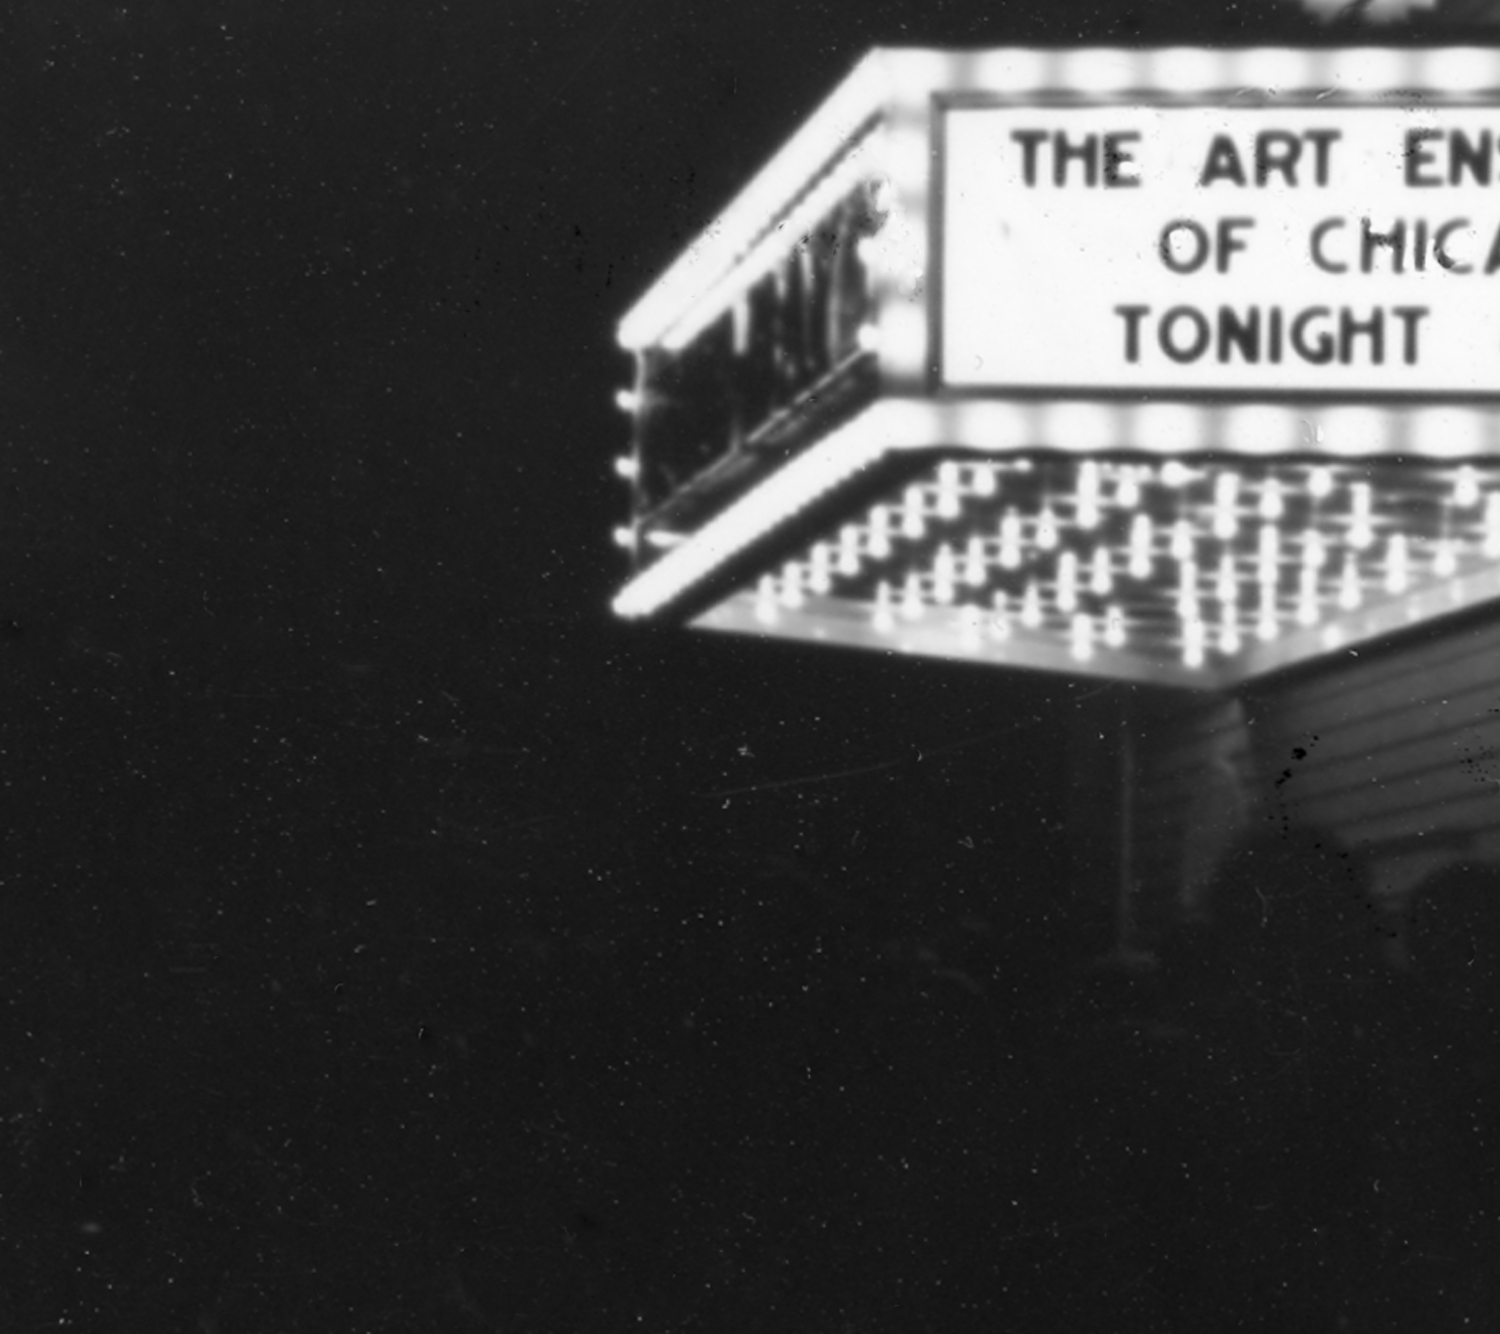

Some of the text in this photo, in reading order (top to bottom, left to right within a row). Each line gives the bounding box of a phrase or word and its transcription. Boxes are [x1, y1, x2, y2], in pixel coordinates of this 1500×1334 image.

[1011, 130, 1140, 188] THE
[1199, 129, 1341, 187] ART
[1159, 218, 1253, 274] OF
[1116, 306, 1428, 365] TONIGHT
